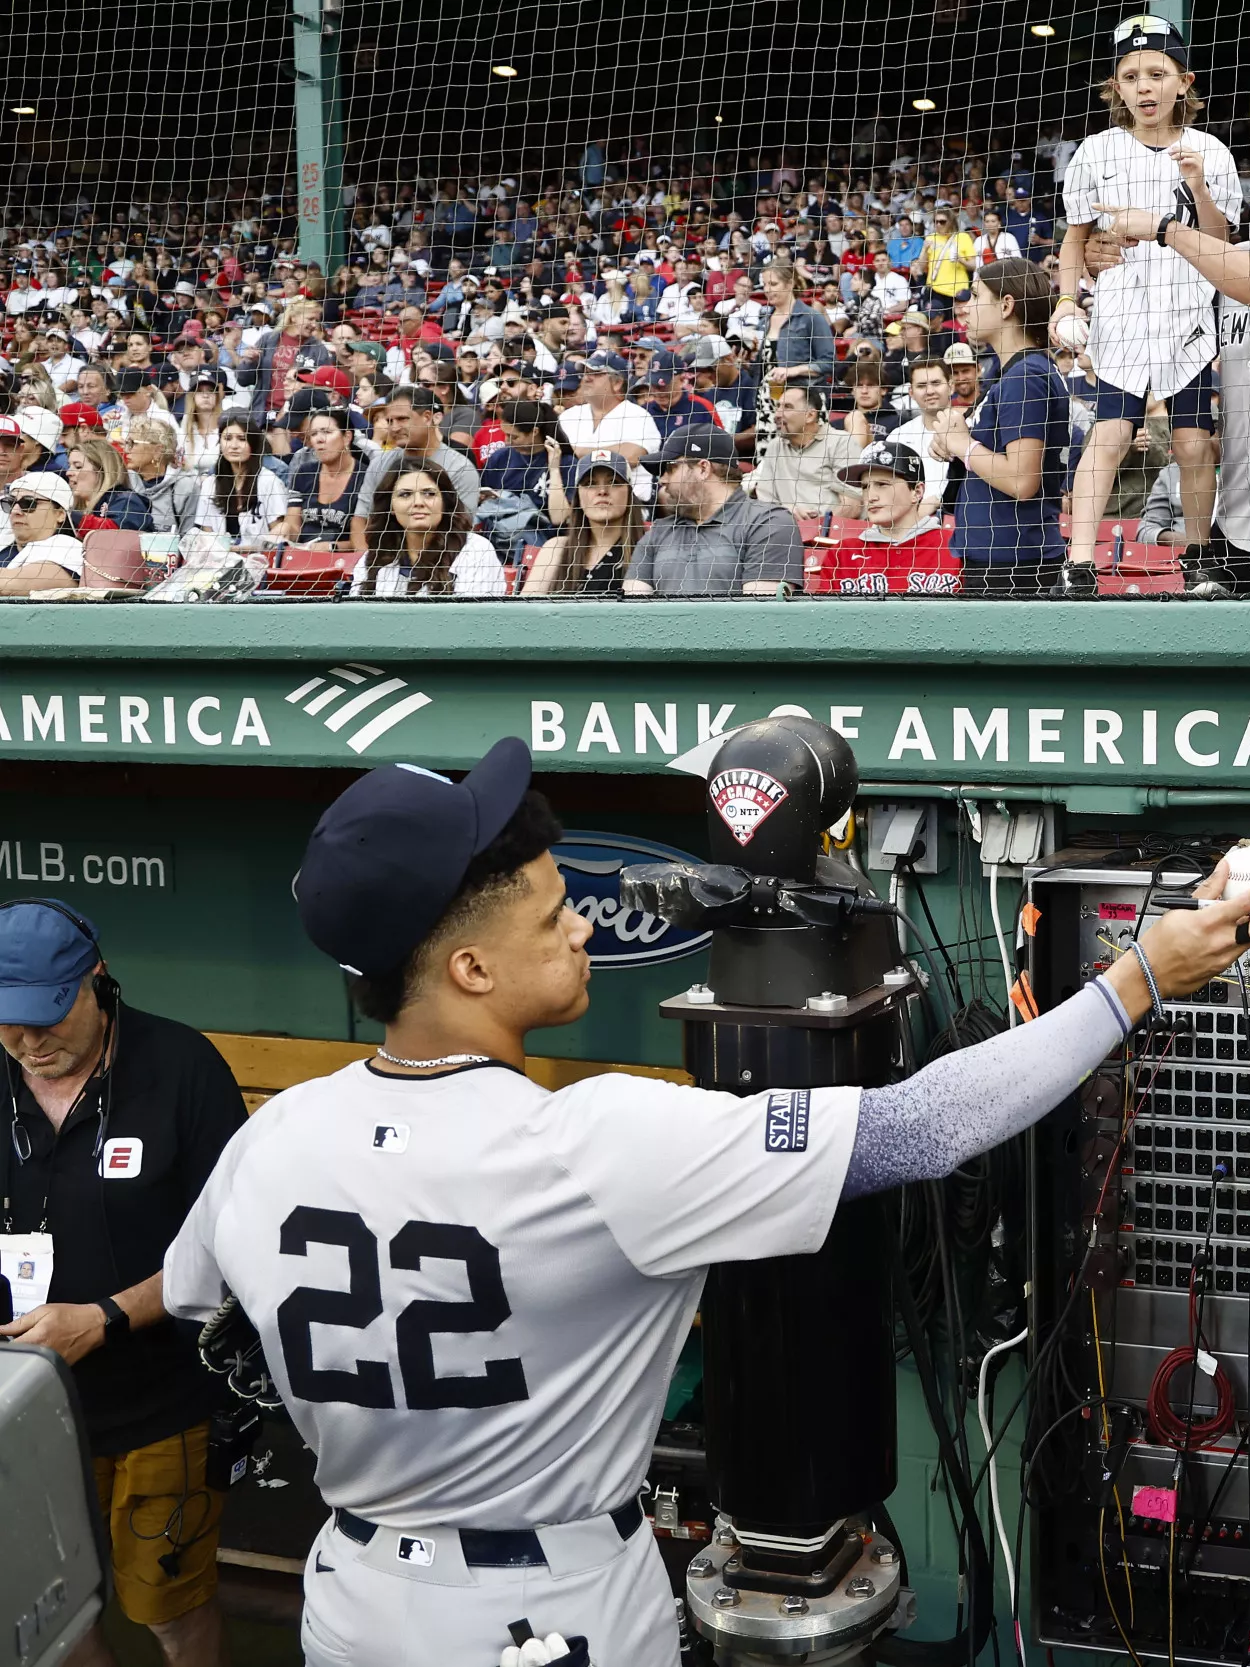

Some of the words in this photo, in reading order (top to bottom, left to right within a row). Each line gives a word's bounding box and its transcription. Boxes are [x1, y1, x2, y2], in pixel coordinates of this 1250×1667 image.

[302, 162, 319, 183] 25
[303, 197, 320, 217] 26
[1220, 310, 1250, 348] EW
[907, 572, 957, 594] SOX
[711, 771, 785, 800] BALLPARK
[726, 785, 758, 801] CAM
[740, 808, 760, 816] NTT
[53, 986, 70, 1006] FILA
[109, 1147, 132, 1168] E
[276, 1204, 530, 1410] 22
